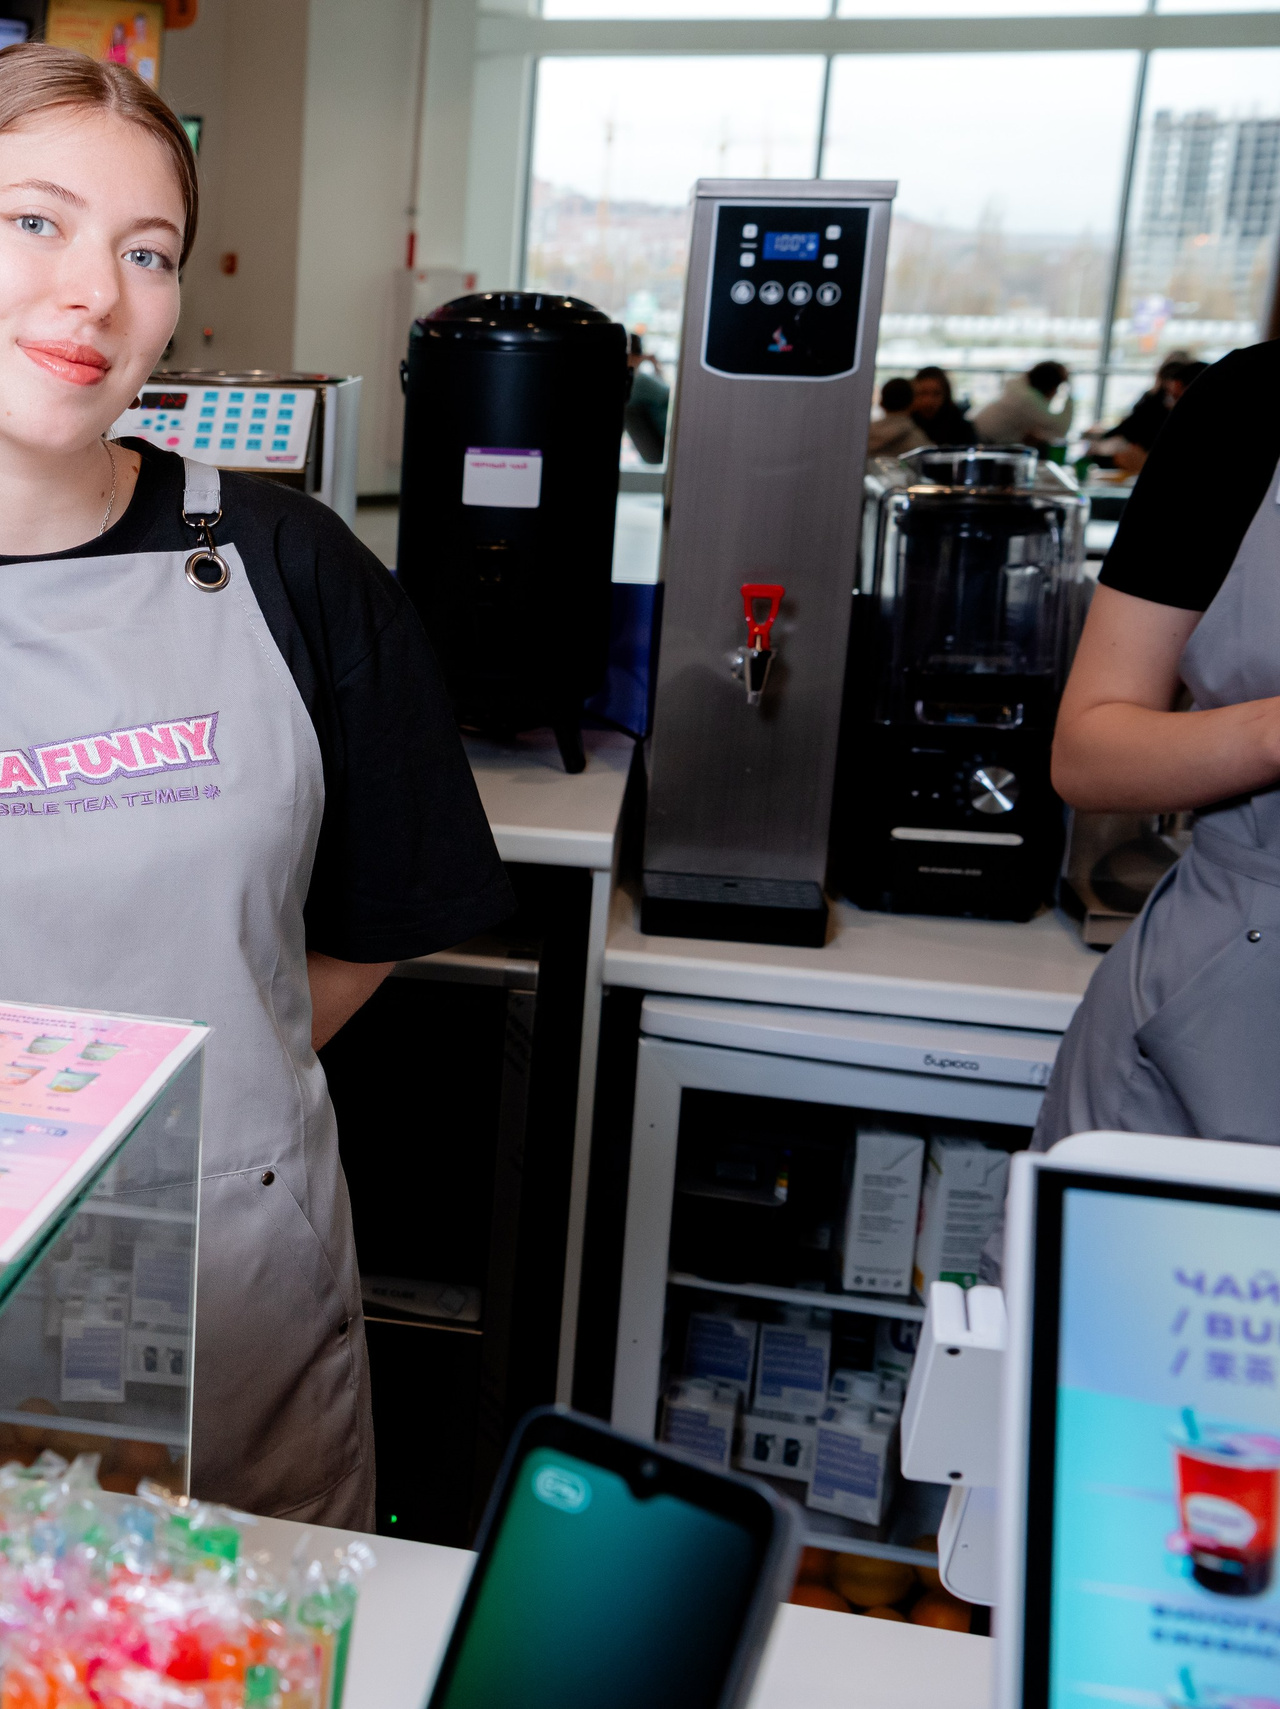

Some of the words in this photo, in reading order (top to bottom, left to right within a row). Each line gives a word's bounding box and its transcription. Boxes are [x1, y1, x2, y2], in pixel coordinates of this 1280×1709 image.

[36, 718, 211, 787] FUNNY
[62, 794, 118, 814] TEA
[120, 783, 200, 807] TIME!
[1206, 1312, 1280, 1346] BU
